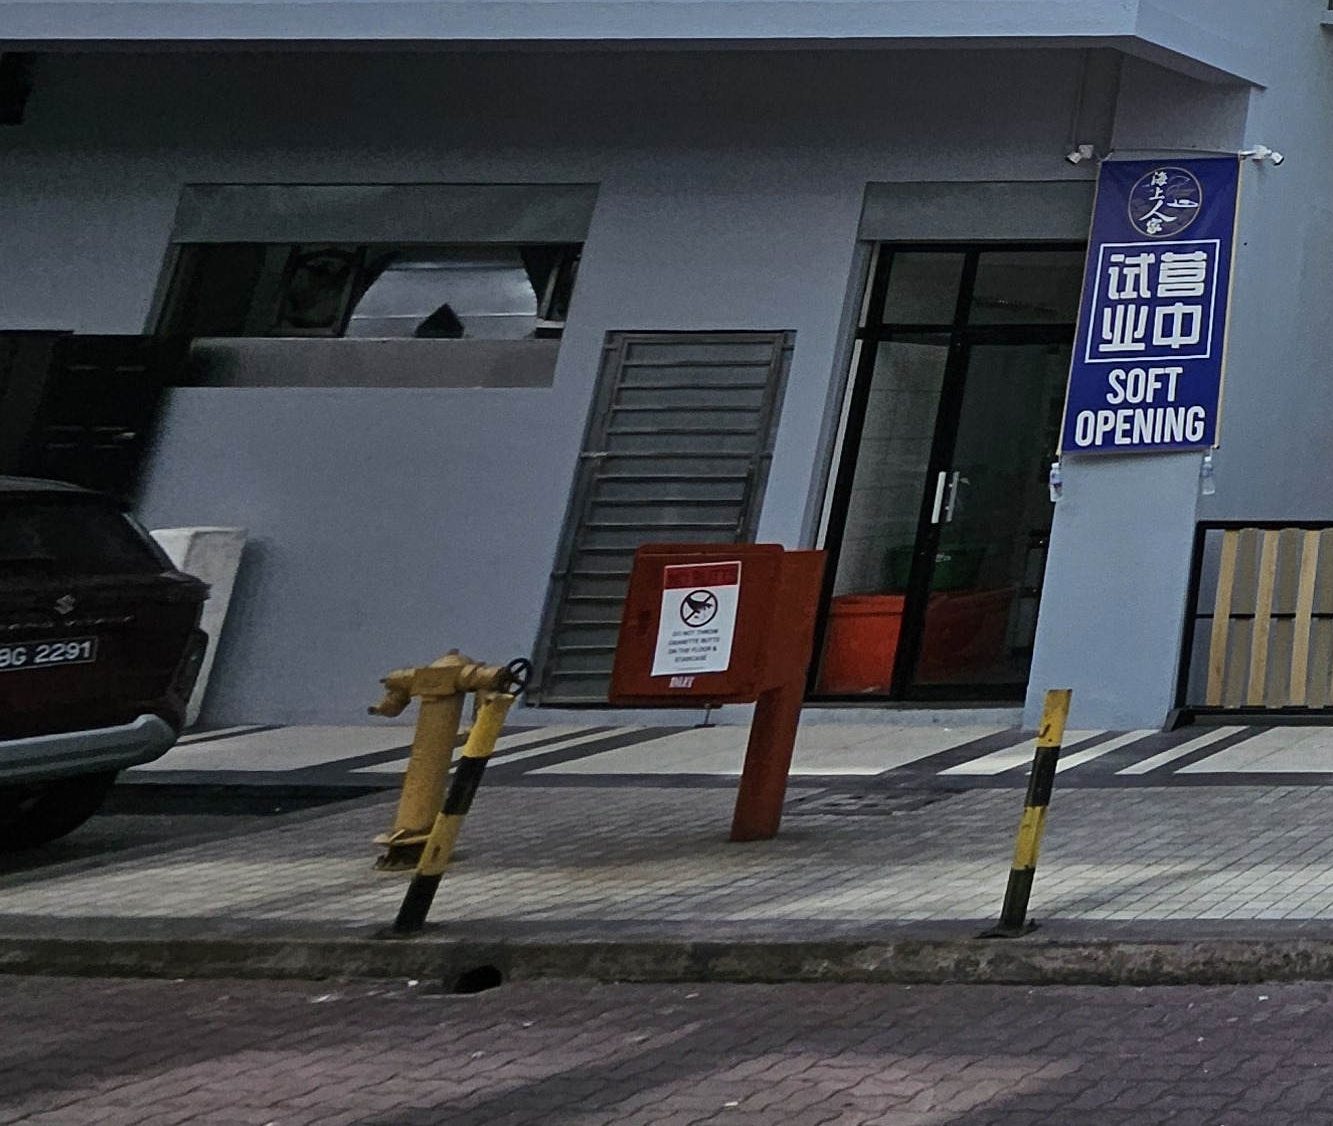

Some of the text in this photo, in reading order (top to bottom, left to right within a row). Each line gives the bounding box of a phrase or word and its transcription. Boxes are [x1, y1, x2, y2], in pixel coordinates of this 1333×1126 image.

[1107, 250, 1207, 300] 试营
[1098, 302, 1202, 352] 业中
[1106, 367, 1183, 405] SOFT
[1074, 406, 1206, 447] OPENING
[33, 640, 91, 663] 2291
